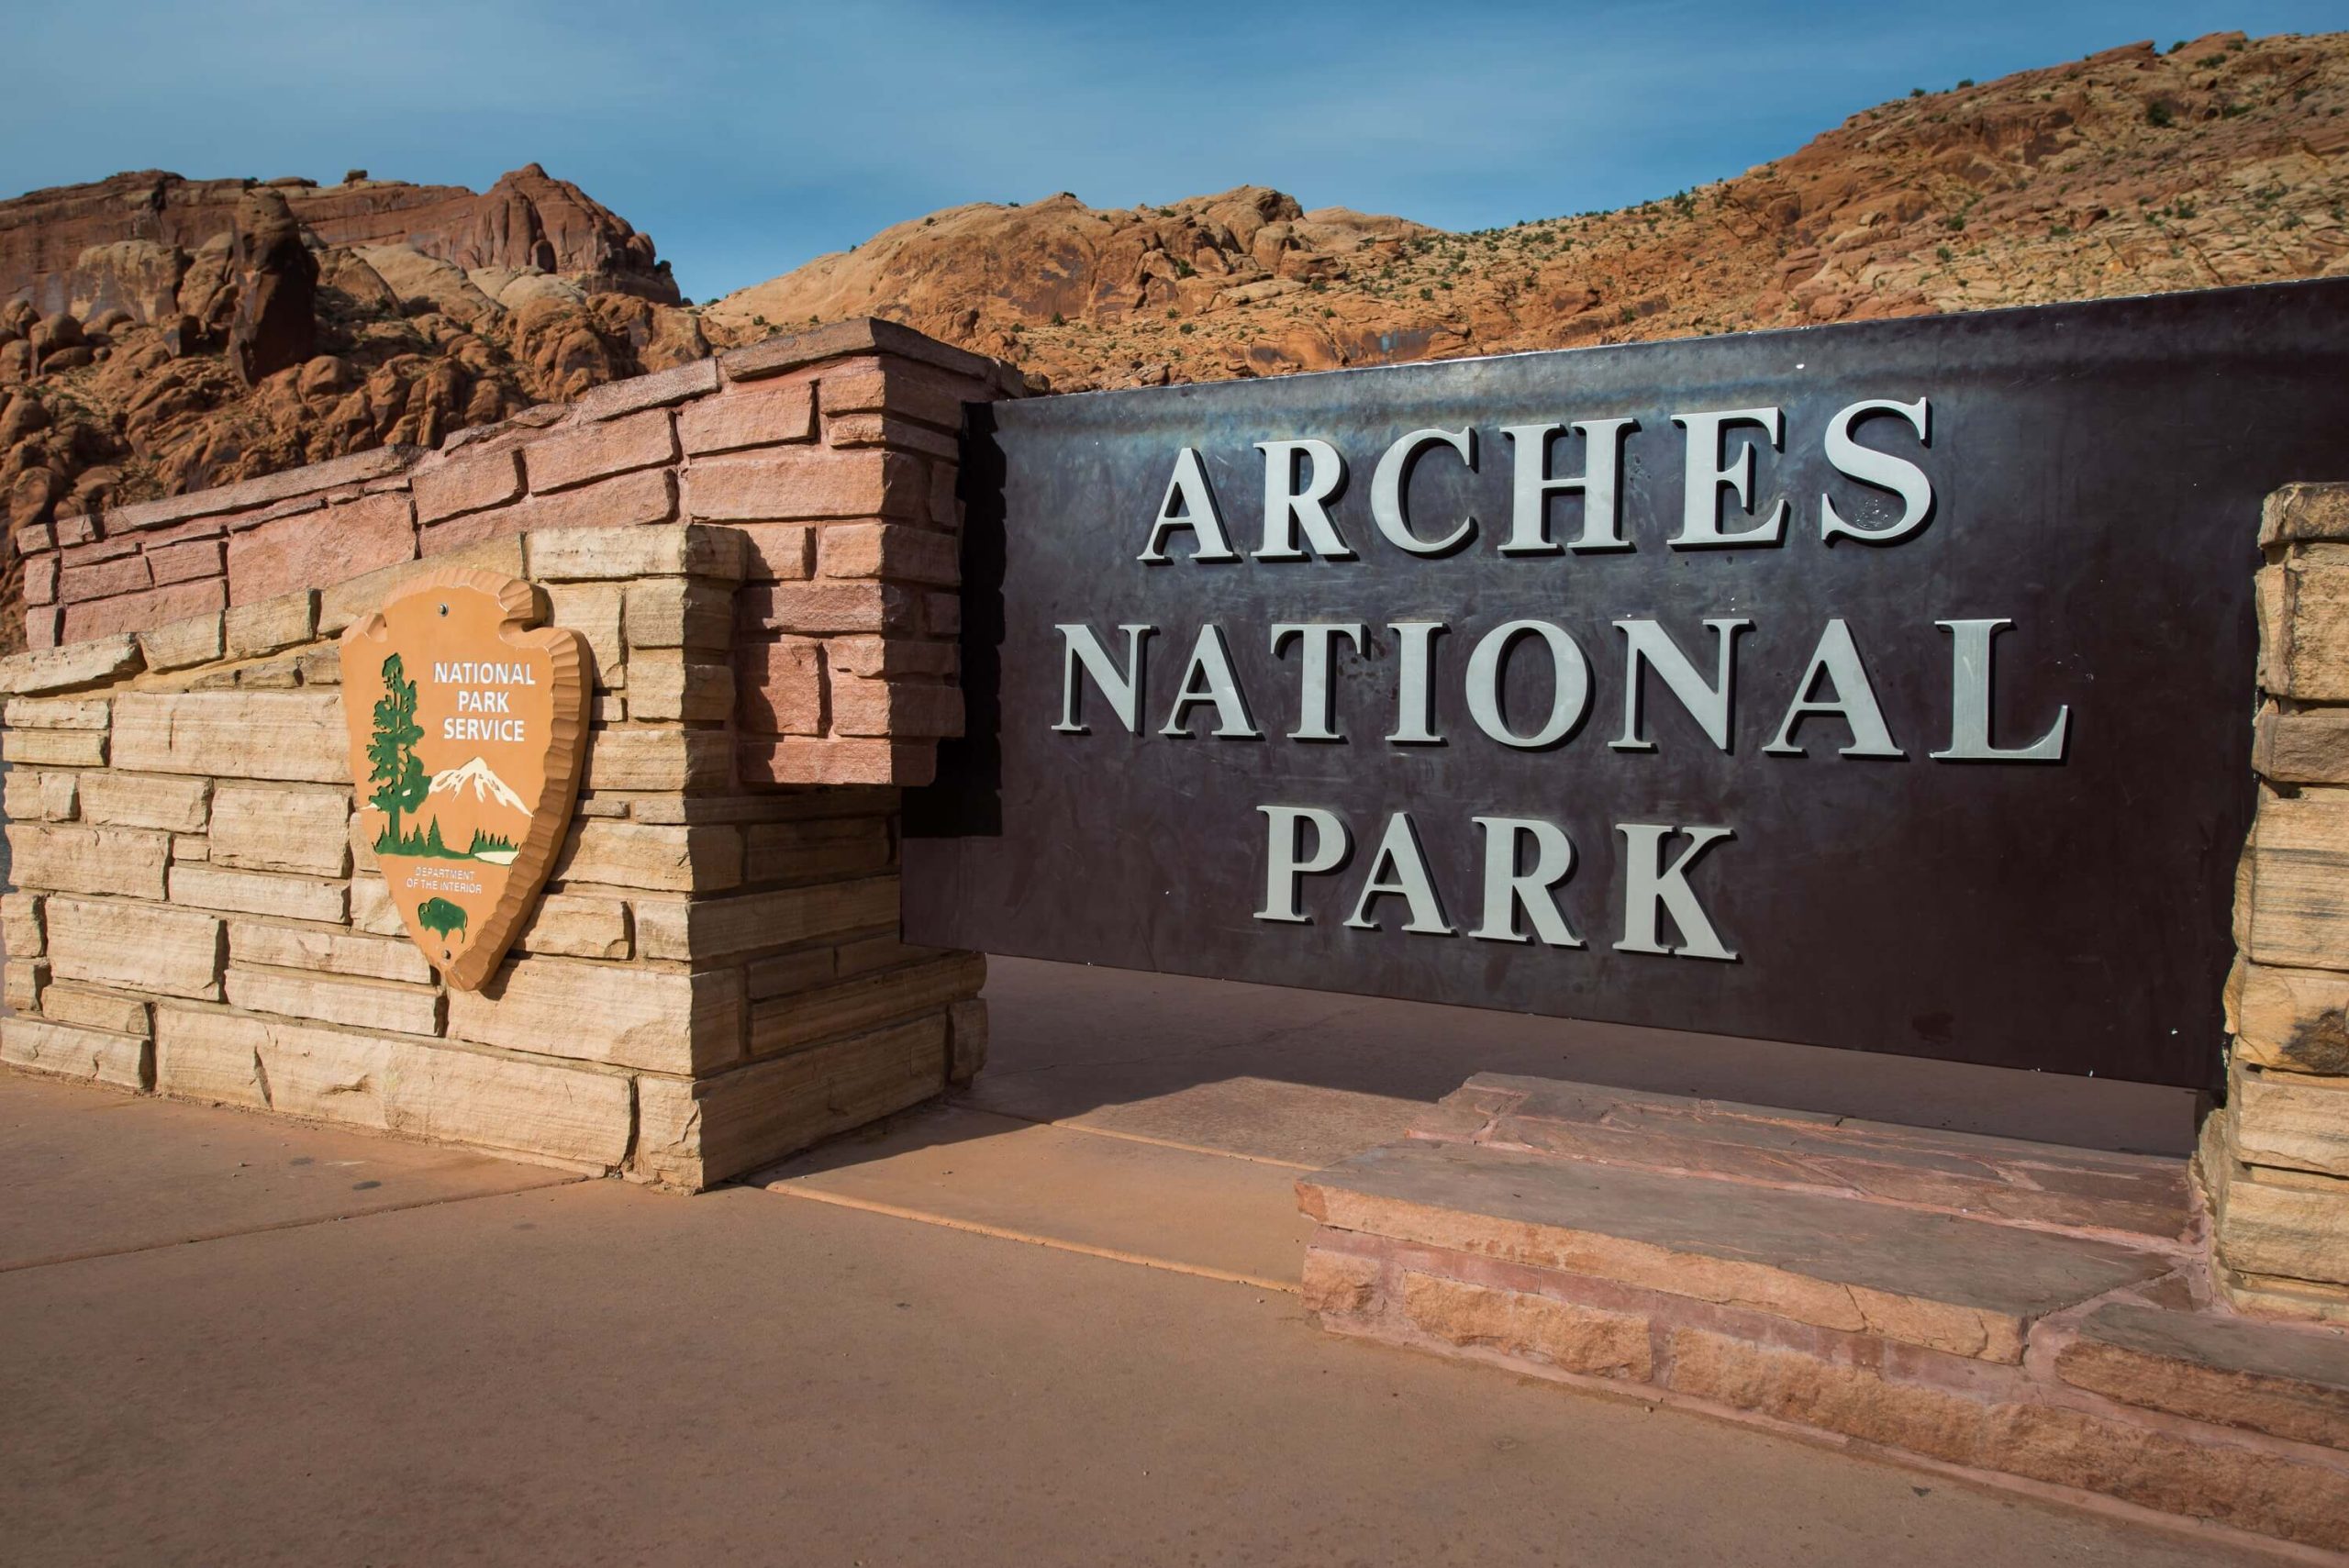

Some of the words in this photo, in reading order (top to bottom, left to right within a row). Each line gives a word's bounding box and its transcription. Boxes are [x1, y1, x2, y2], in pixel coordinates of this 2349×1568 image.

[1137, 396, 1933, 561] ARCHES
[433, 662, 536, 685] NATIONAL
[1051, 617, 2069, 760] NATIONAL
[458, 691, 509, 713] PARK
[443, 718, 525, 741] SERVICE
[416, 866, 474, 881] DEPARTMENT
[1253, 805, 1738, 961] PARK
[406, 878, 418, 888] OF
[421, 879, 438, 890] THE
[440, 882, 482, 894] INTERIOR
